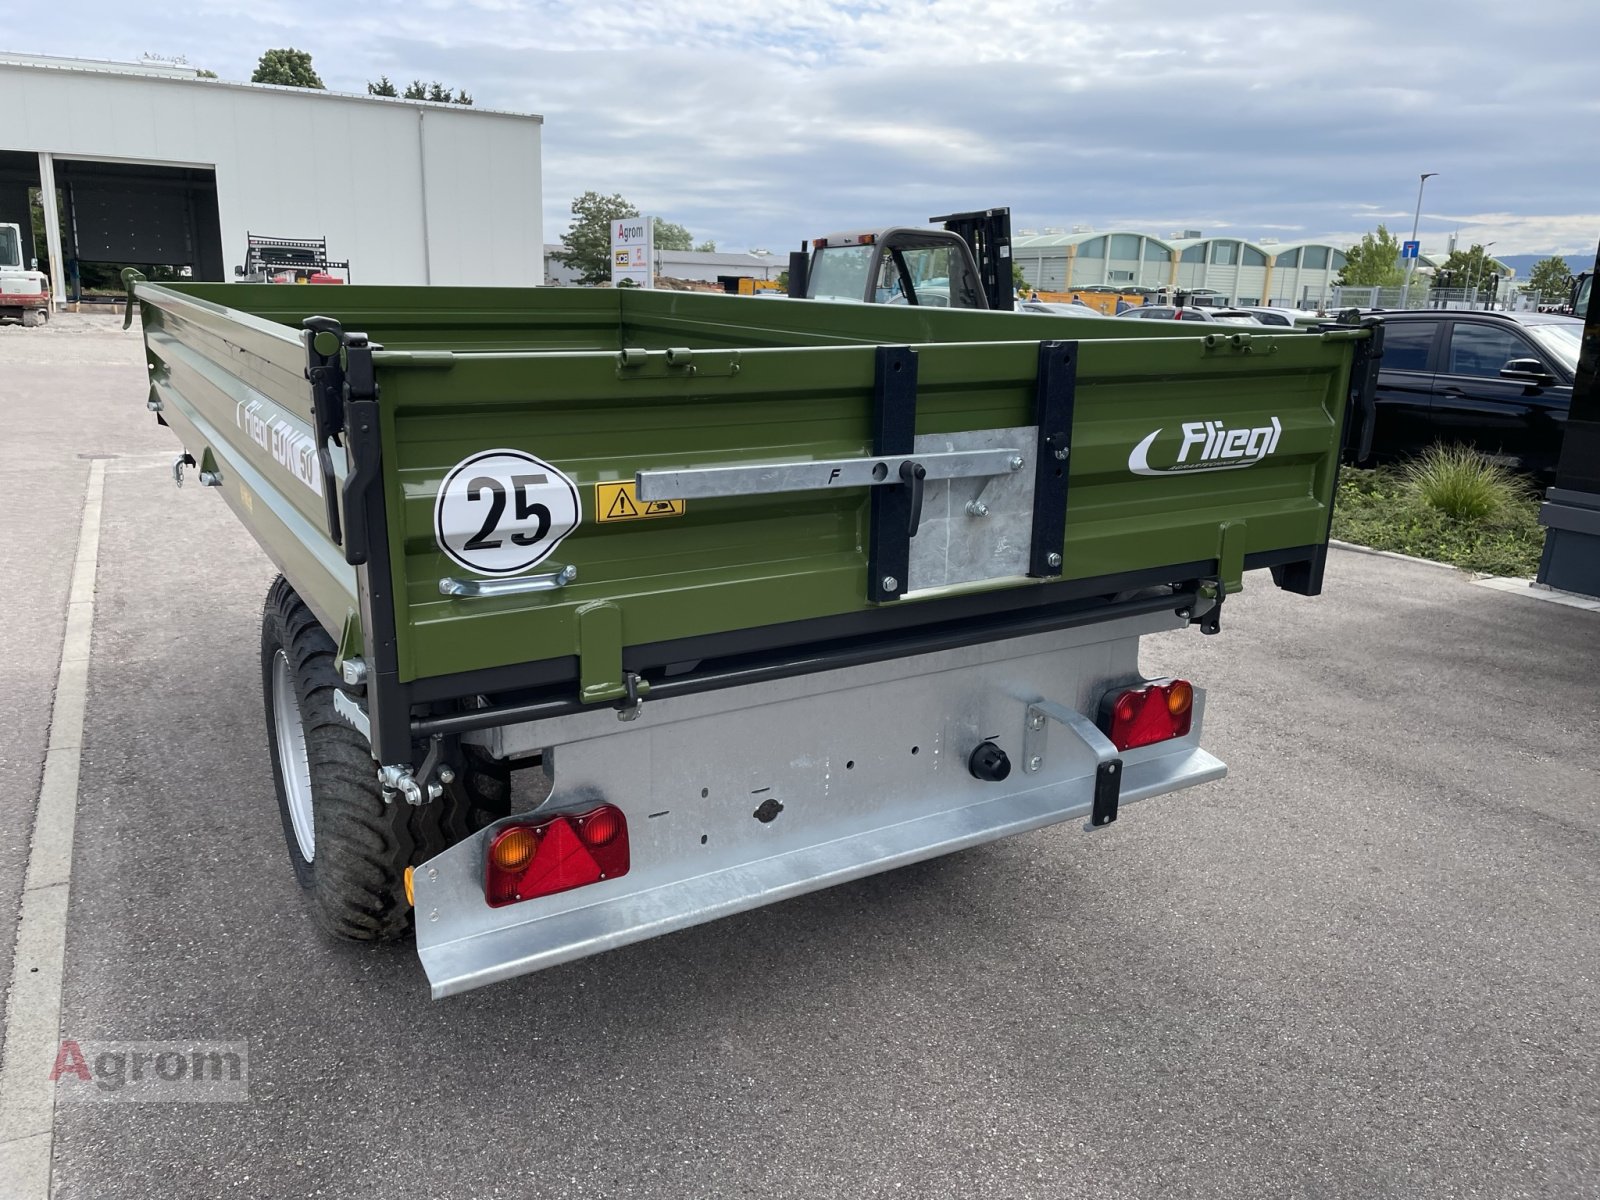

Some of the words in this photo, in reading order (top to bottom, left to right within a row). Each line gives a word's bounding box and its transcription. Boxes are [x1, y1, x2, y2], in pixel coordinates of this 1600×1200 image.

[618, 223, 644, 242] Agrom
[1176, 416, 1282, 463] Fliegl
[827, 468, 842, 485] F
[463, 474, 552, 551] 25
